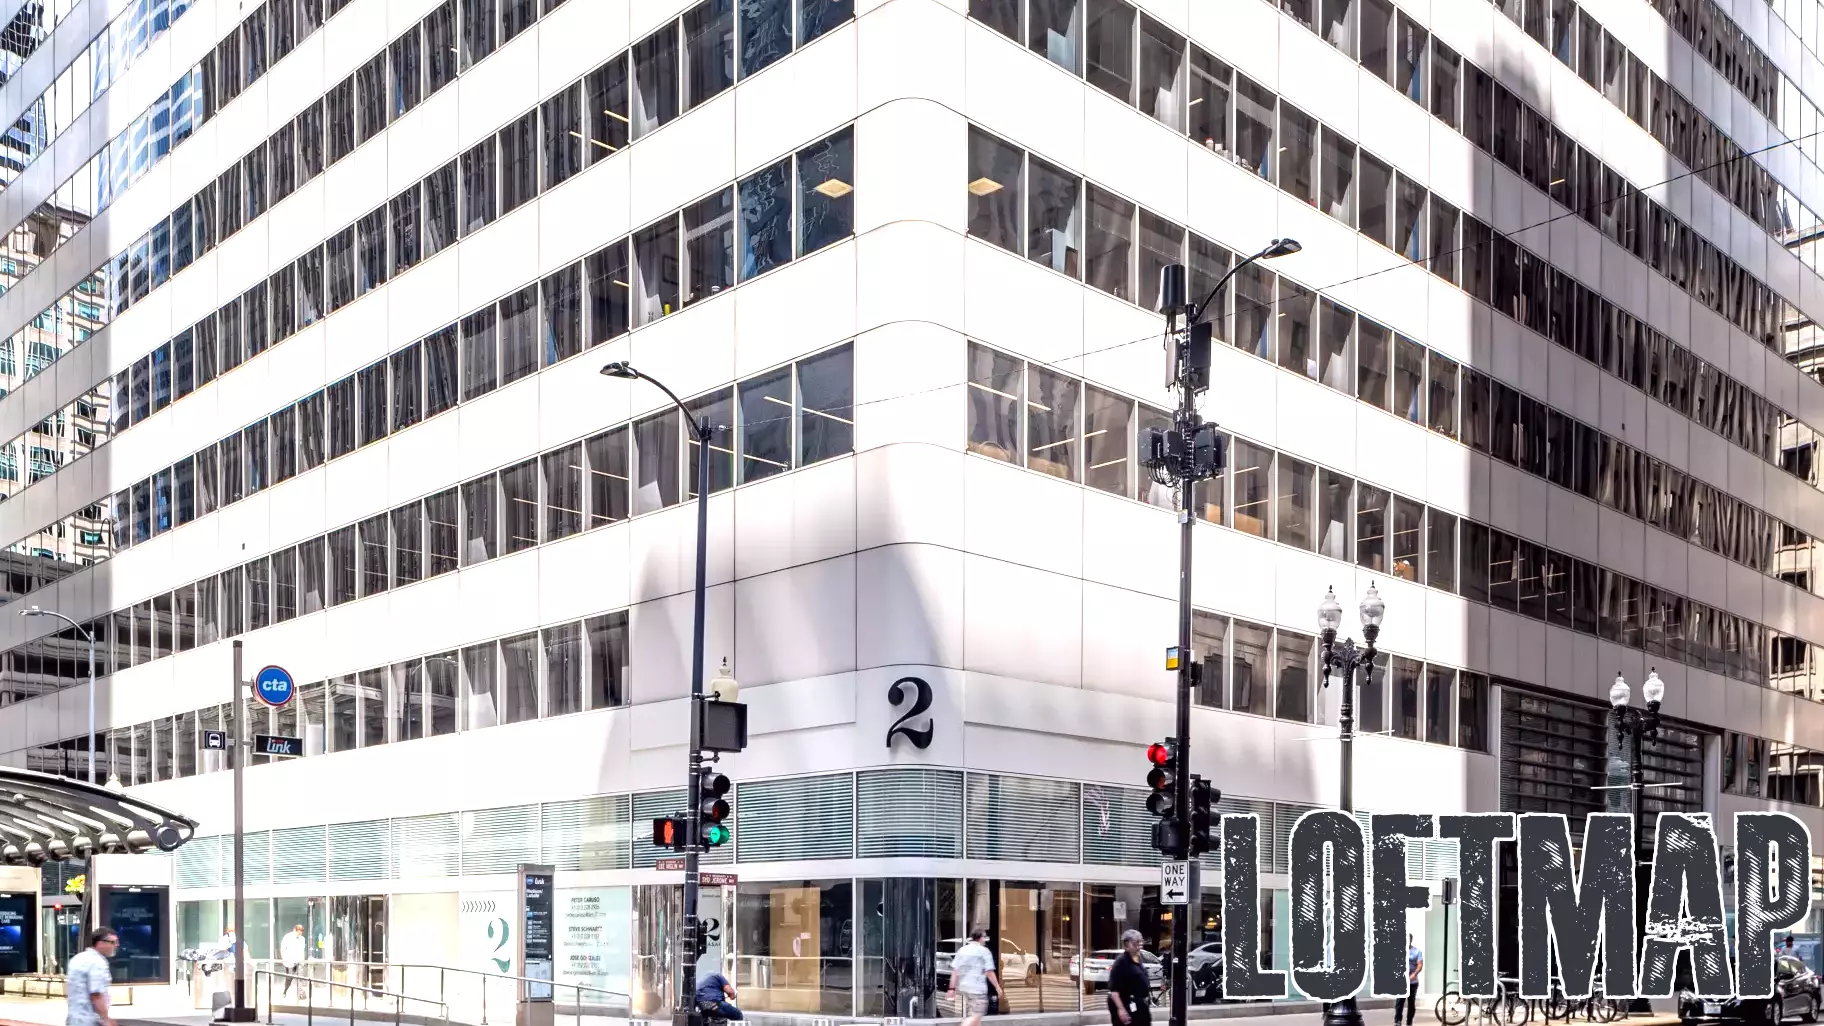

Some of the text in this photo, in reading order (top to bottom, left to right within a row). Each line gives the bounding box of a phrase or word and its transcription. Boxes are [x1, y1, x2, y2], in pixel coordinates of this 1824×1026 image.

[262, 679, 288, 692] cta
[887, 677, 933, 749] 2
[1164, 865, 1185, 875] ONE
[1164, 877, 1186, 887] WAY
[702, 917, 720, 942] 2
[488, 917, 511, 974] 2
